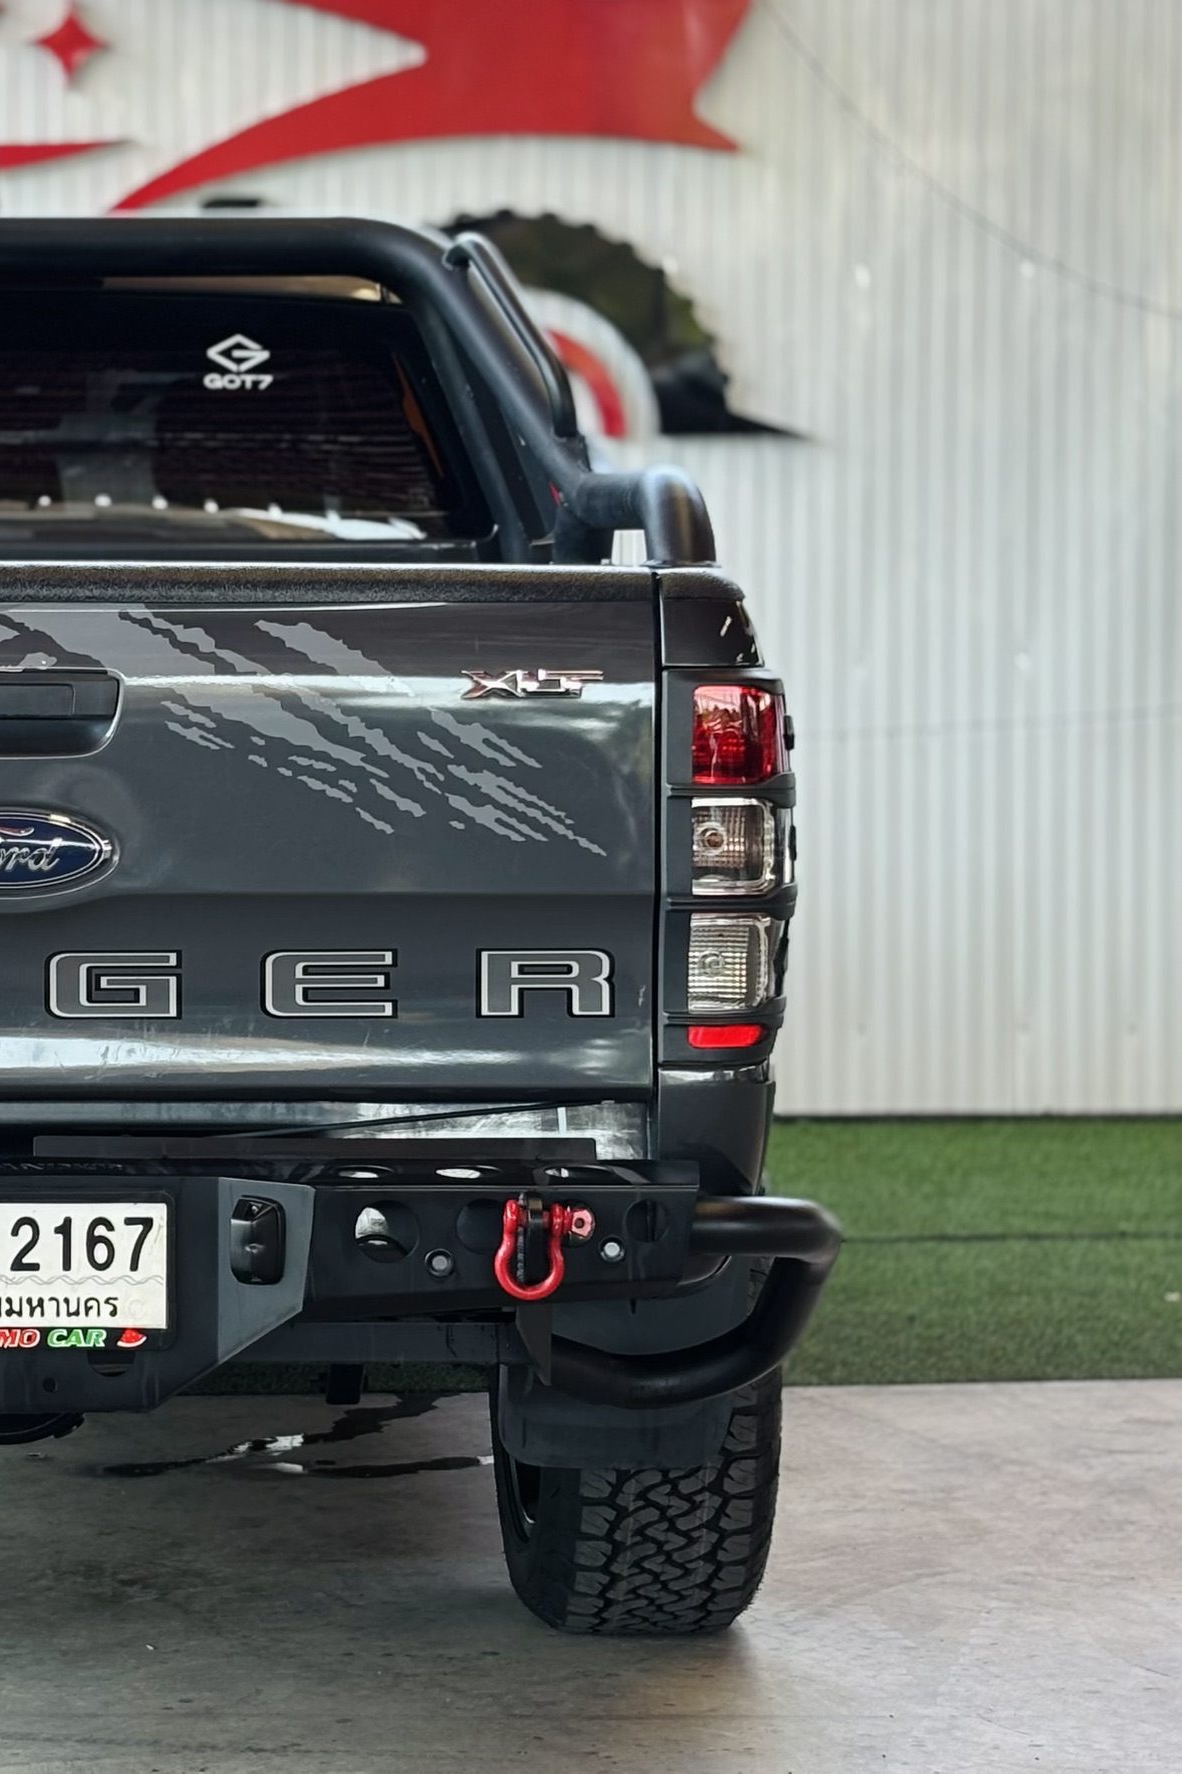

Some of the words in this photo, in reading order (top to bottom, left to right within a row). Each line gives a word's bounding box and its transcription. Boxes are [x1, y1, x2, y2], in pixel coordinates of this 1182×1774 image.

[203, 373, 274, 391] GOT7
[460, 668, 604, 701] XLT
[10, 1215, 155, 1273] 2167
[47, 1328, 107, 1349] CAR
